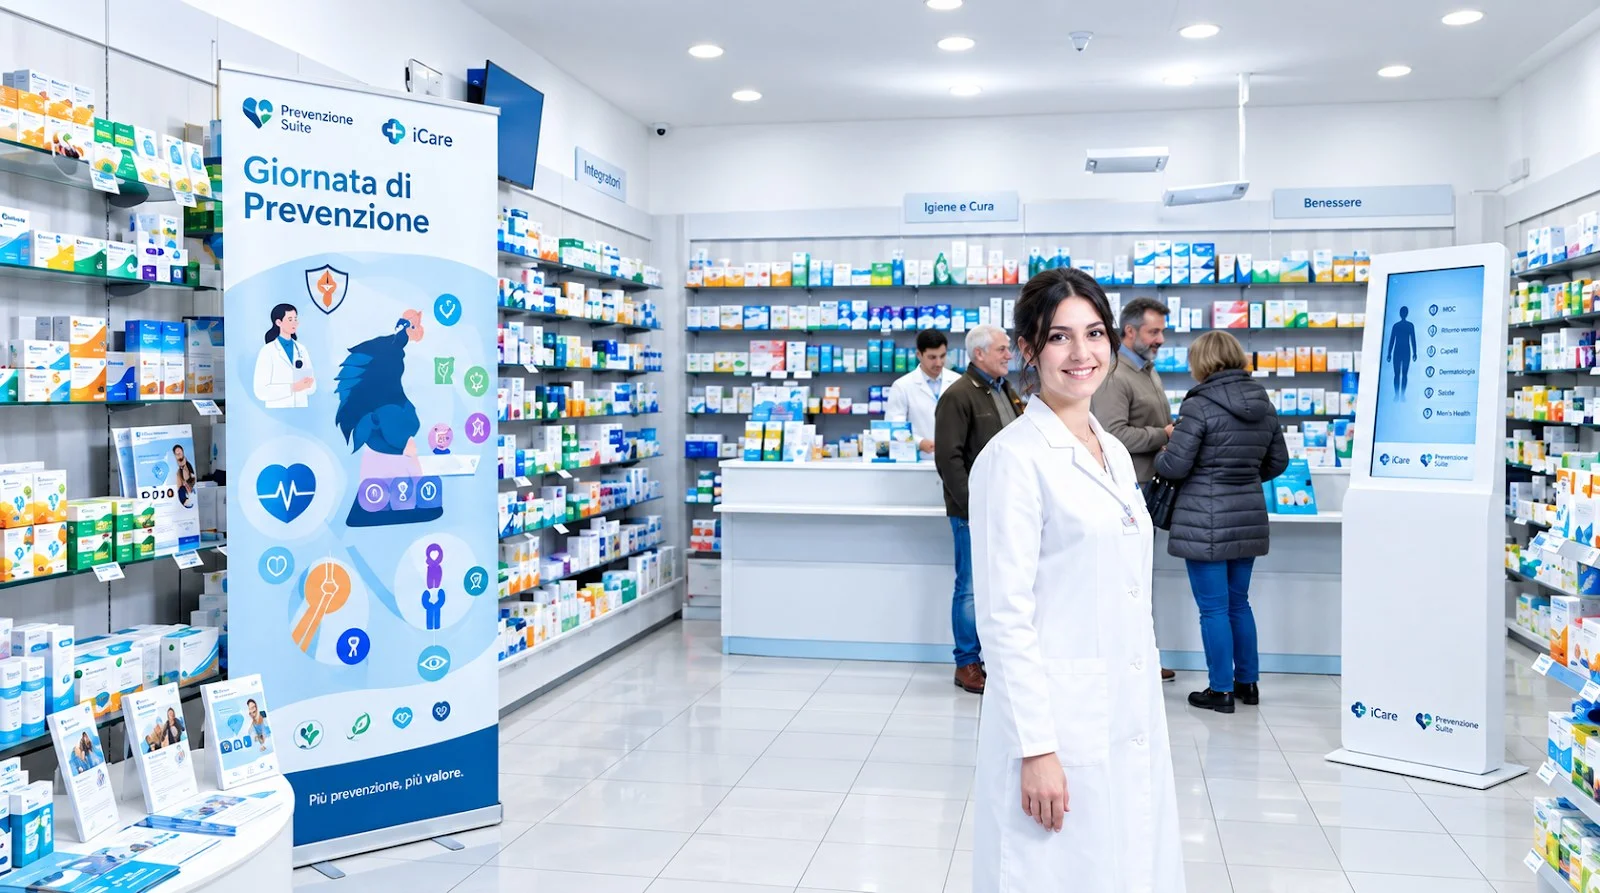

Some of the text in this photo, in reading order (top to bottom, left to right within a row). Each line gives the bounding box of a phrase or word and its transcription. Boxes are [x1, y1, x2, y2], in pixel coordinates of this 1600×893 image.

[281, 105, 354, 126] Prevenzione
[281, 119, 312, 134] Suite
[412, 127, 453, 147] iCare
[243, 155, 411, 199] Giornata di
[584, 160, 621, 190] Integratori
[924, 201, 994, 215] Igiene e Cura
[1304, 197, 1362, 208] Benessere
[244, 191, 430, 234] Prevenzione
[1439, 368, 1476, 376] Dermatologia
[1391, 455, 1411, 465] iCare
[1434, 453, 1469, 461] Prevenzione
[1370, 707, 1398, 721] iCare
[1435, 715, 1479, 729] Prevenzione
[1435, 724, 1454, 734] Suite
[309, 769, 464, 806] Più prevenzione, più valore.
